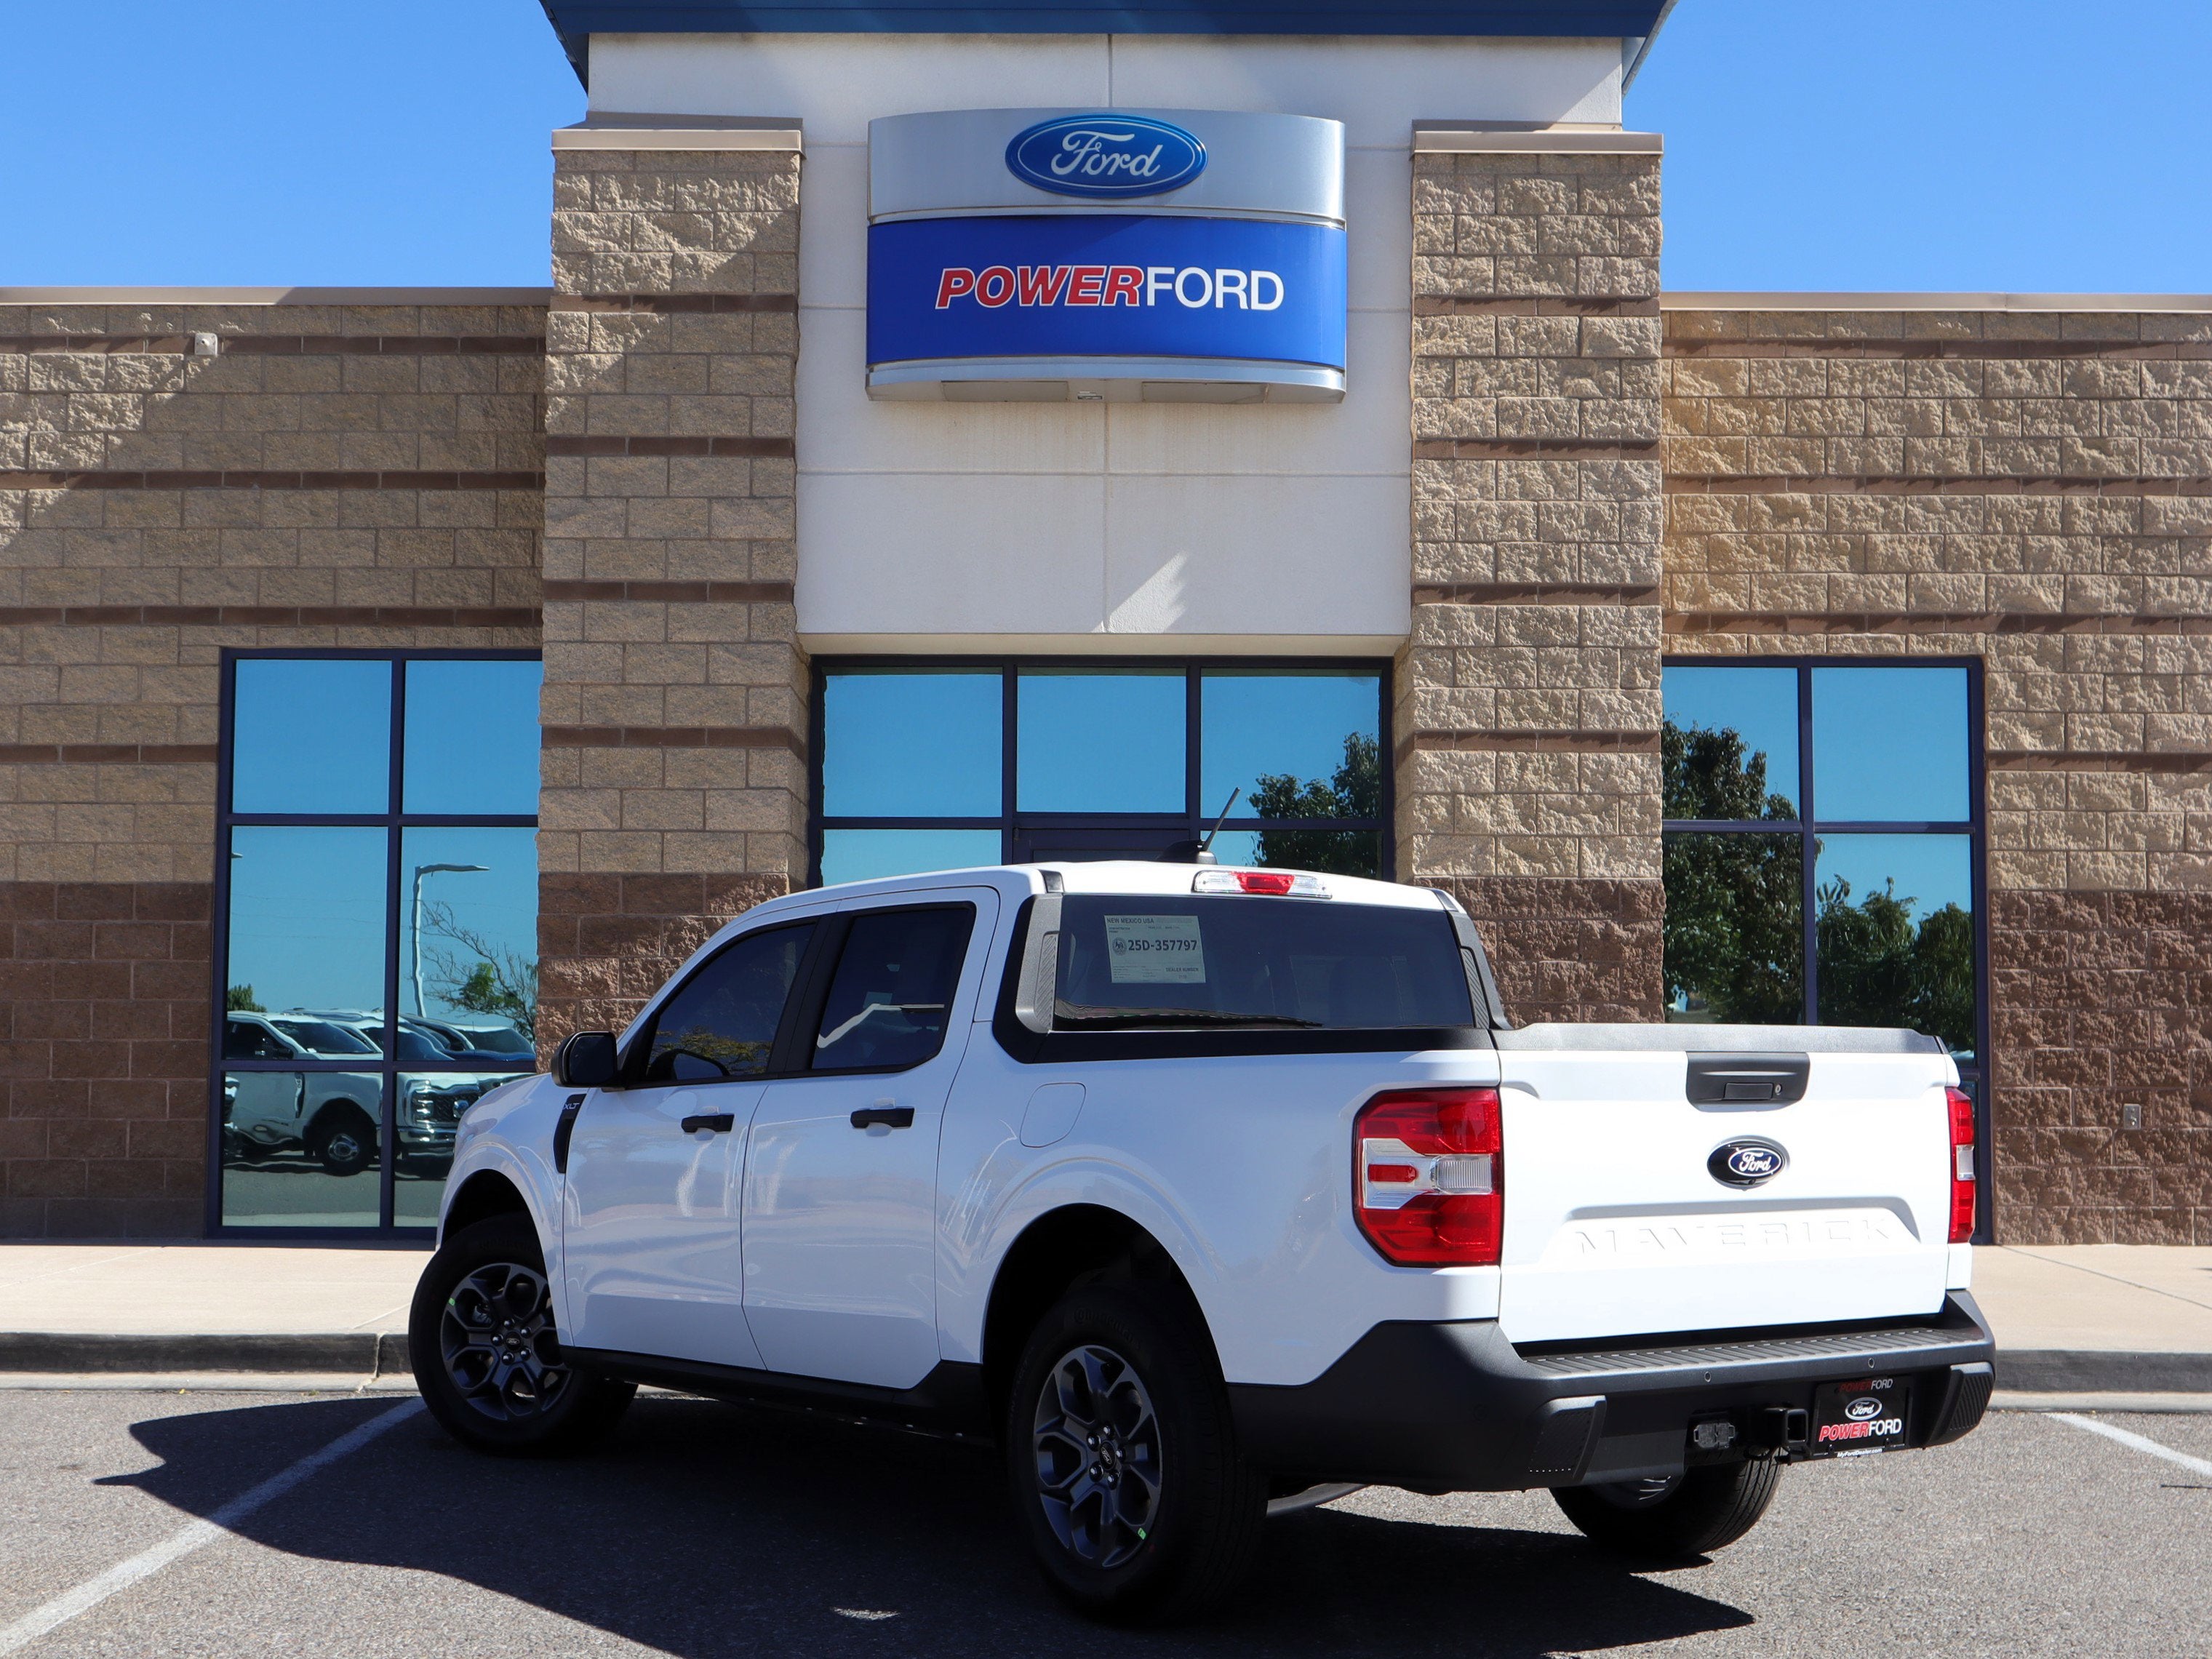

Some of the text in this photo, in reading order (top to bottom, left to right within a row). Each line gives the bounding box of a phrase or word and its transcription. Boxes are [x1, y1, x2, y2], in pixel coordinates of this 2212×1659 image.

[1050, 130, 1163, 177] Ford
[935, 265, 1285, 311] POWERFORD
[1128, 940, 1197, 951] 25D-357797
[1739, 1151, 1772, 1172] Ford
[1574, 1219, 1890, 1254] MAVERICK
[1838, 1378, 1893, 1392] POWERFORD
[1852, 1402, 1875, 1415] Ford
[1818, 1418, 1902, 1442] POWERFORD
[1837, 1448, 1882, 1458] MyFordDealer.com
